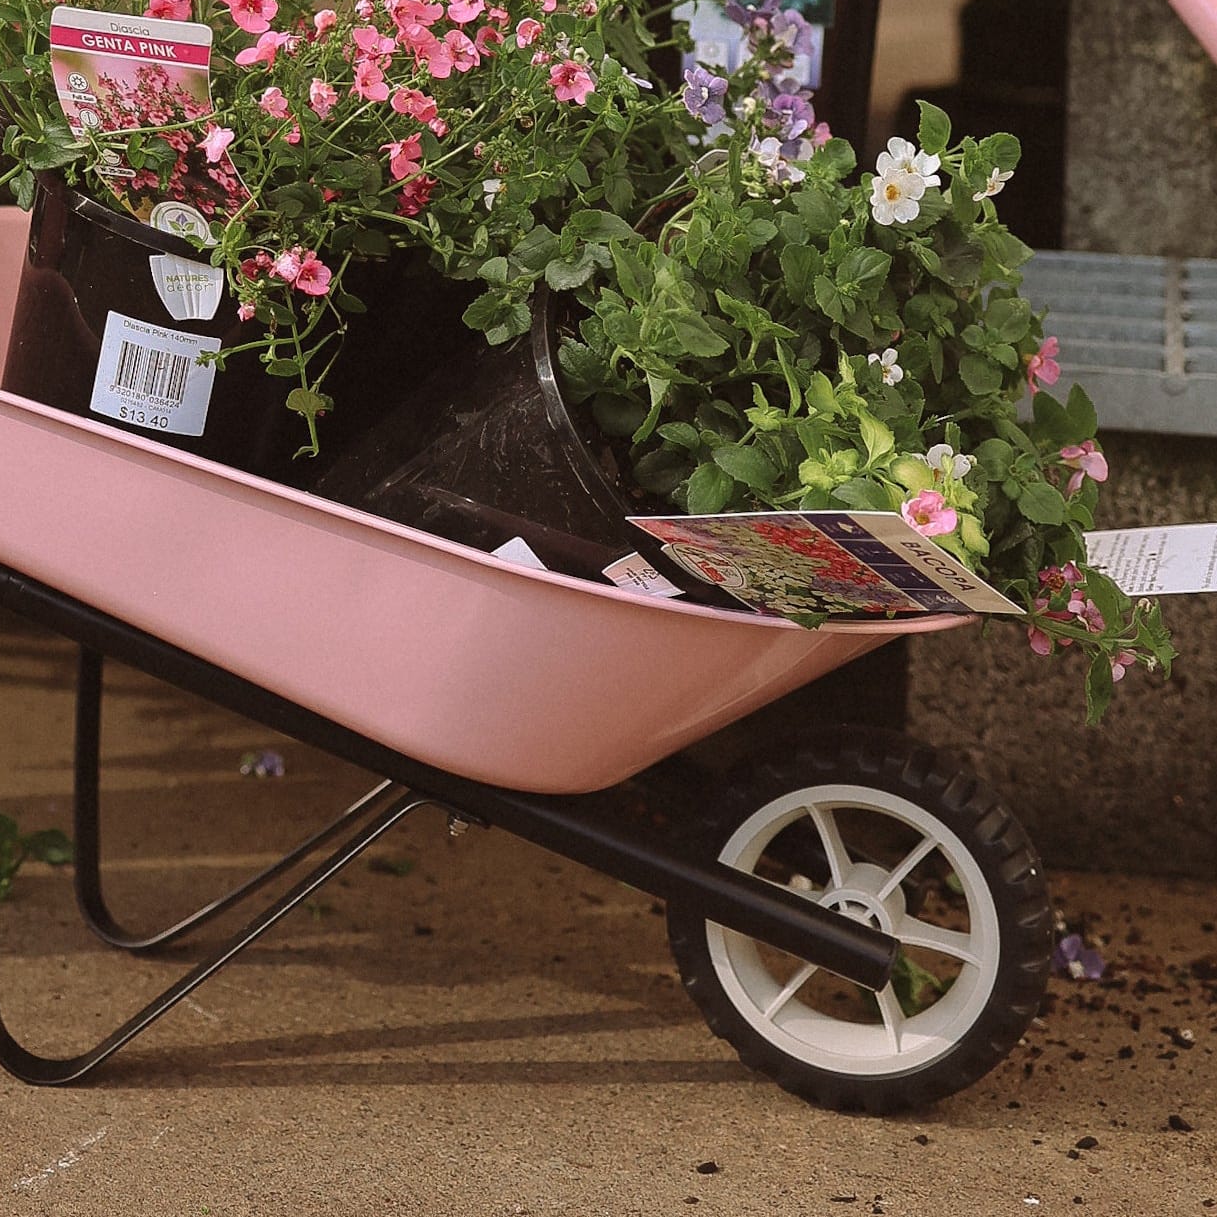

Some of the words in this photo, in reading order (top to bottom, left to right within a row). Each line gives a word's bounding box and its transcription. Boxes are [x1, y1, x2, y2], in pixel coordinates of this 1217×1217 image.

[110, 22, 150, 36] Diascia
[81, 34, 136, 53] GENTA
[139, 41, 177, 58] PINK
[166, 274, 209, 282] NATURES
[123, 319, 150, 334] Diascia
[152, 329, 169, 339] Pink
[119, 406, 169, 429] $13.40
[900, 541, 977, 592] BACOPA
